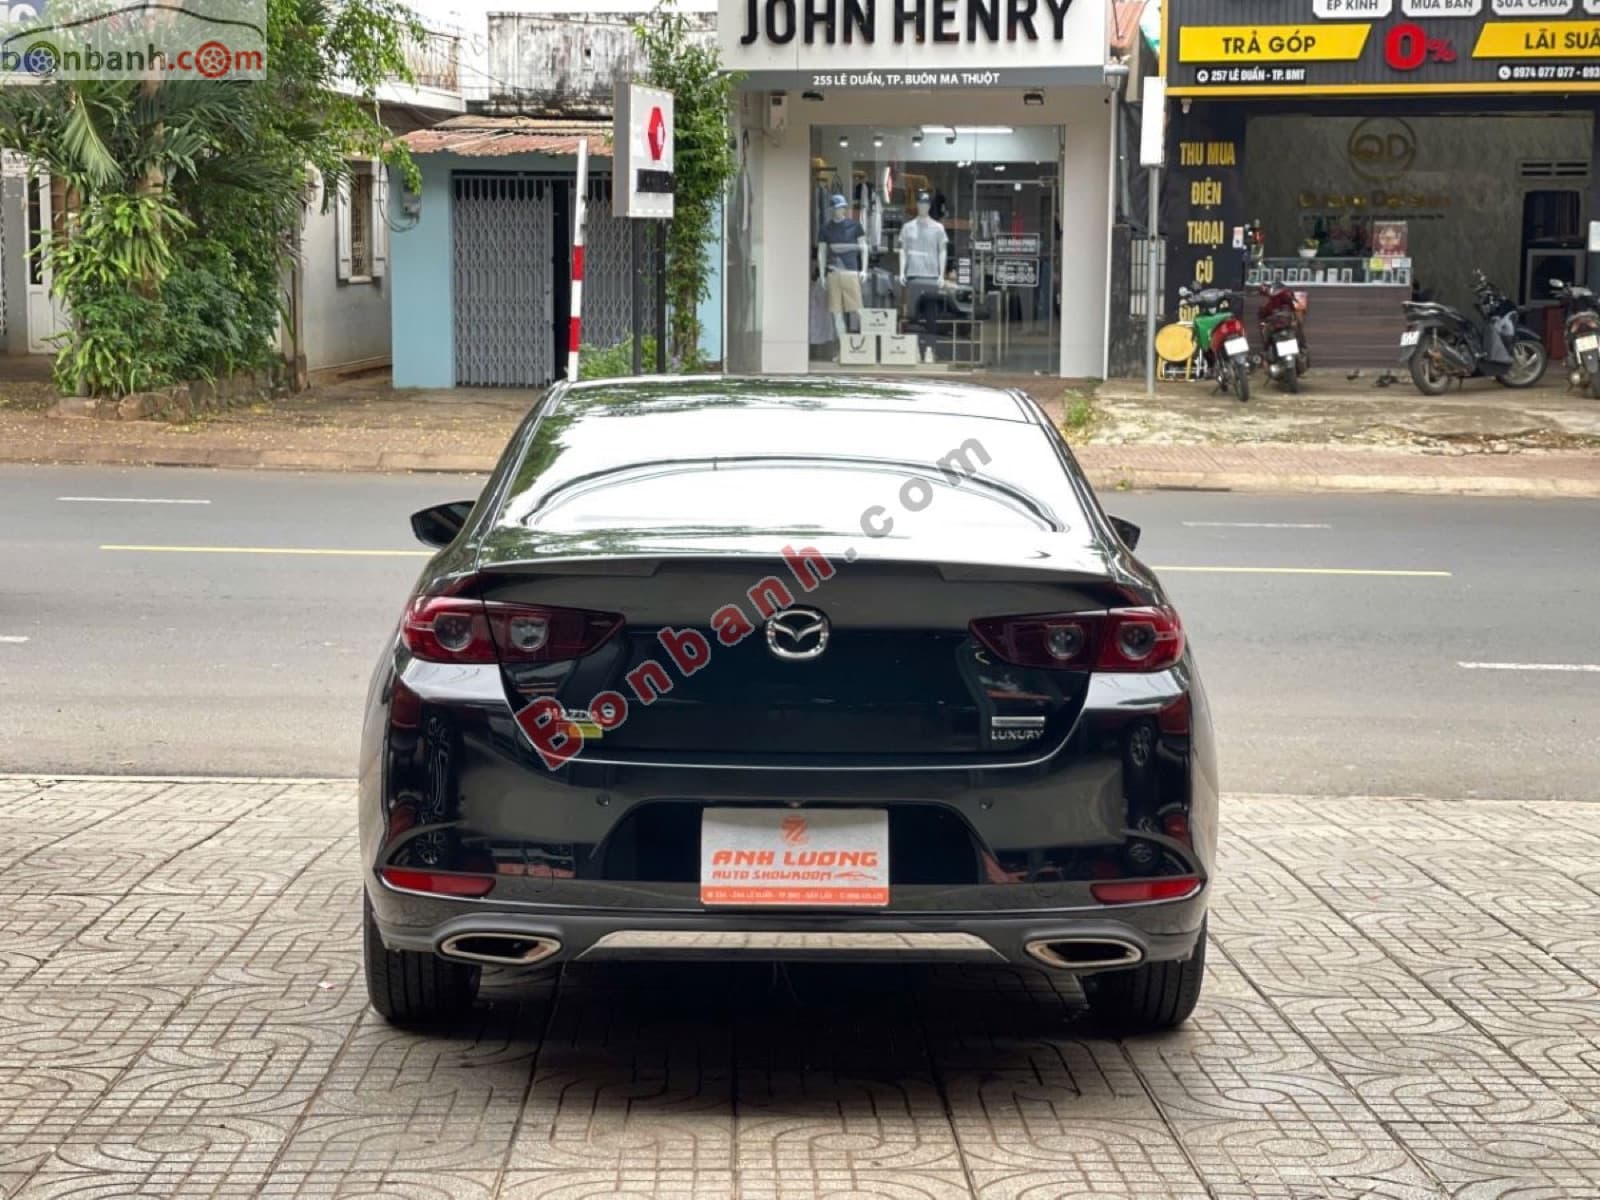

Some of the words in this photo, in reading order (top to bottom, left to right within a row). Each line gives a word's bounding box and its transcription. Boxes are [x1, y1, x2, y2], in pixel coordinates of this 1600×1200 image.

[740, 0, 876, 45] JOHN
[894, 0, 1073, 44] HENRY
[1268, 30, 1316, 53] GÓP
[1385, 23, 1457, 70] 0%
[813, 75, 832, 86] 255
[940, 73, 959, 85] MA
[1211, 69, 1228, 81] 257
[1180, 142, 1203, 165] THU
[1207, 142, 1235, 165] MUA
[1187, 220, 1224, 249] THOẠI
[991, 729, 1045, 740] LUXURY
[712, 850, 775, 866] ANH
[711, 870, 750, 880] AUTO
[751, 870, 833, 882] SHOWROOM
